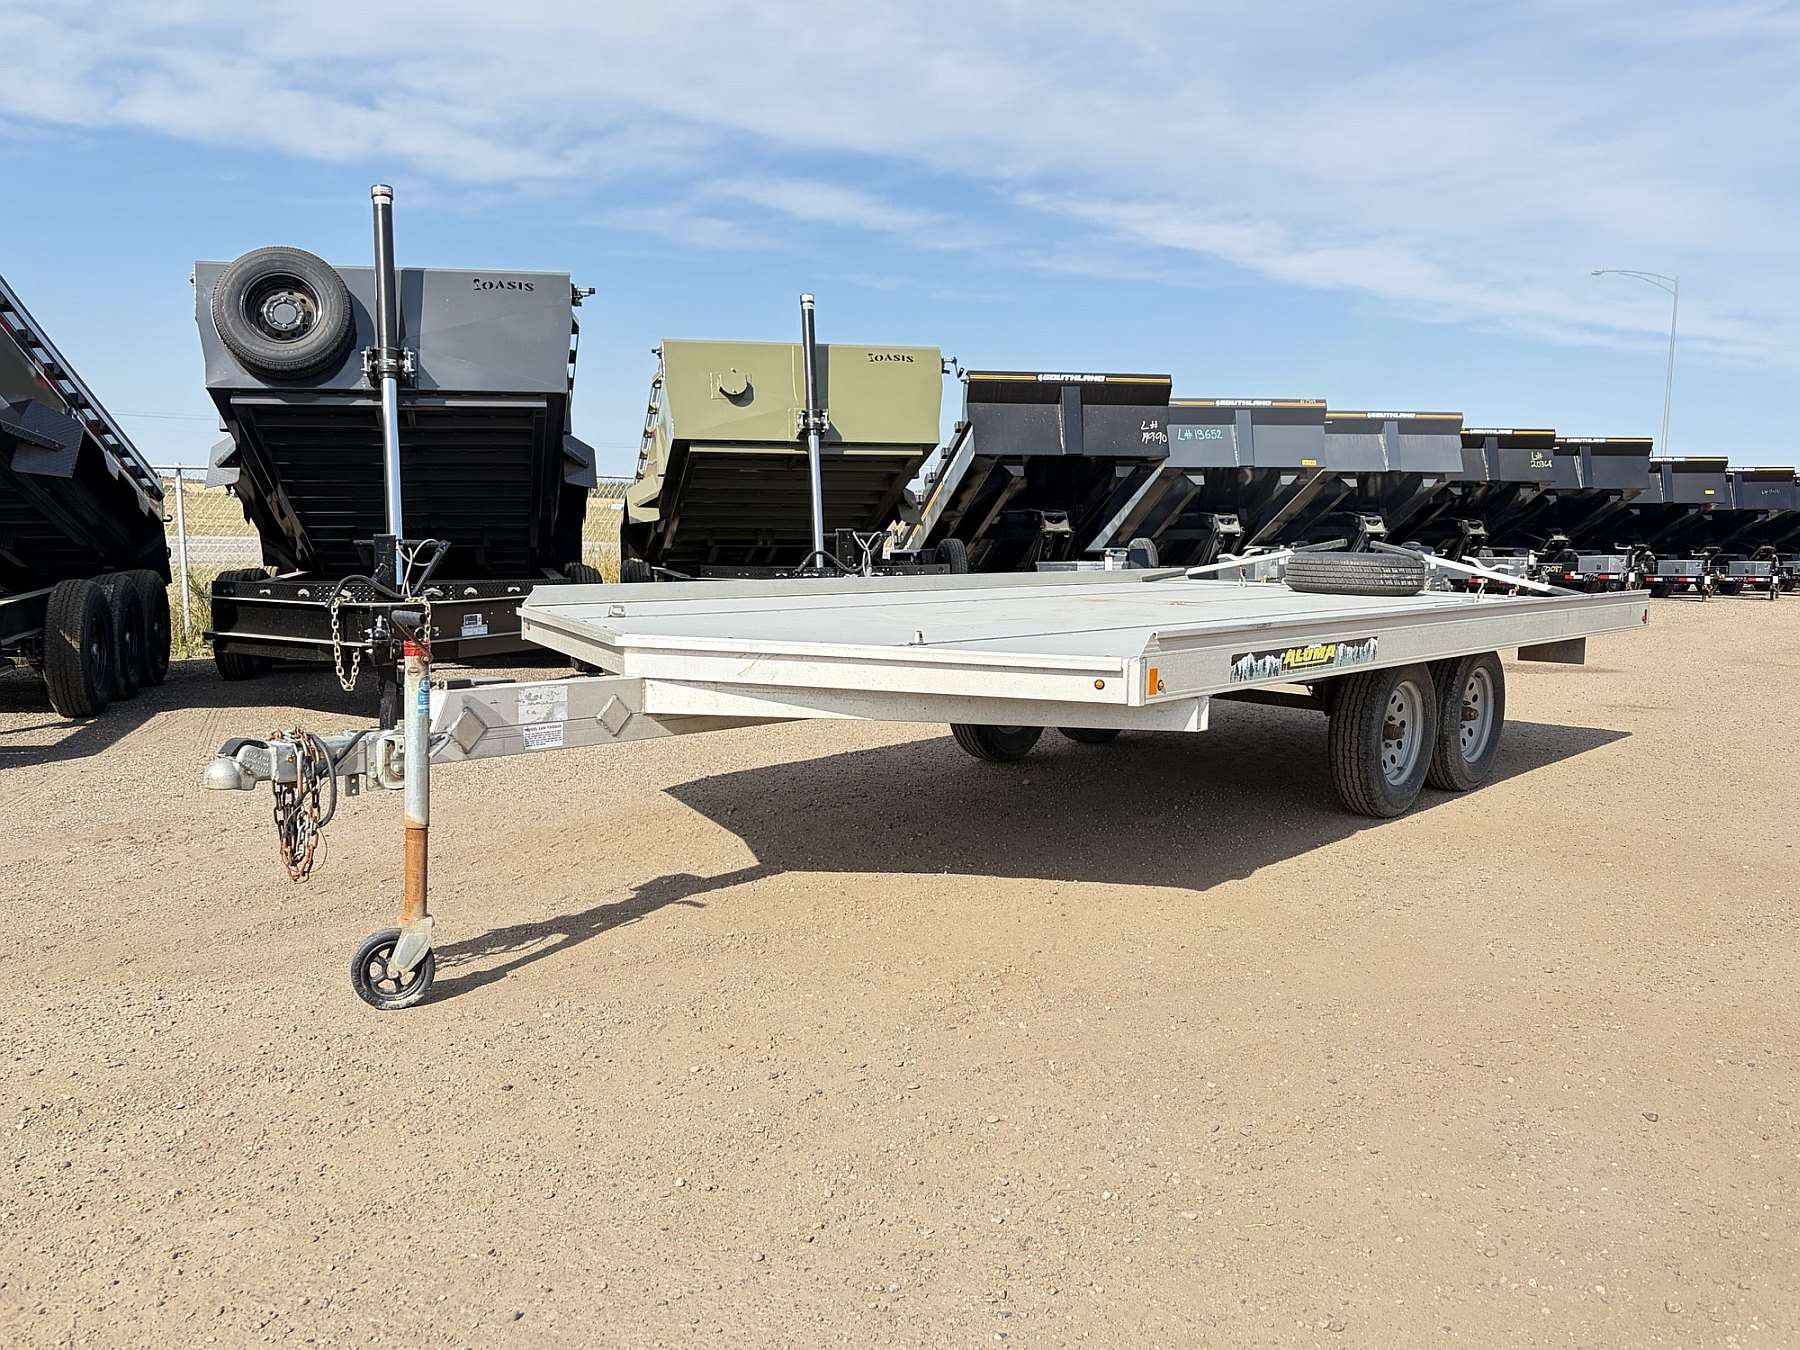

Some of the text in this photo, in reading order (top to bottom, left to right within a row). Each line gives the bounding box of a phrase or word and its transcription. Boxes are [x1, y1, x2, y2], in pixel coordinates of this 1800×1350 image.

[481, 280, 535, 291] OASIS
[874, 353, 914, 363] OASIS
[1283, 643, 1337, 665] ALUMA
